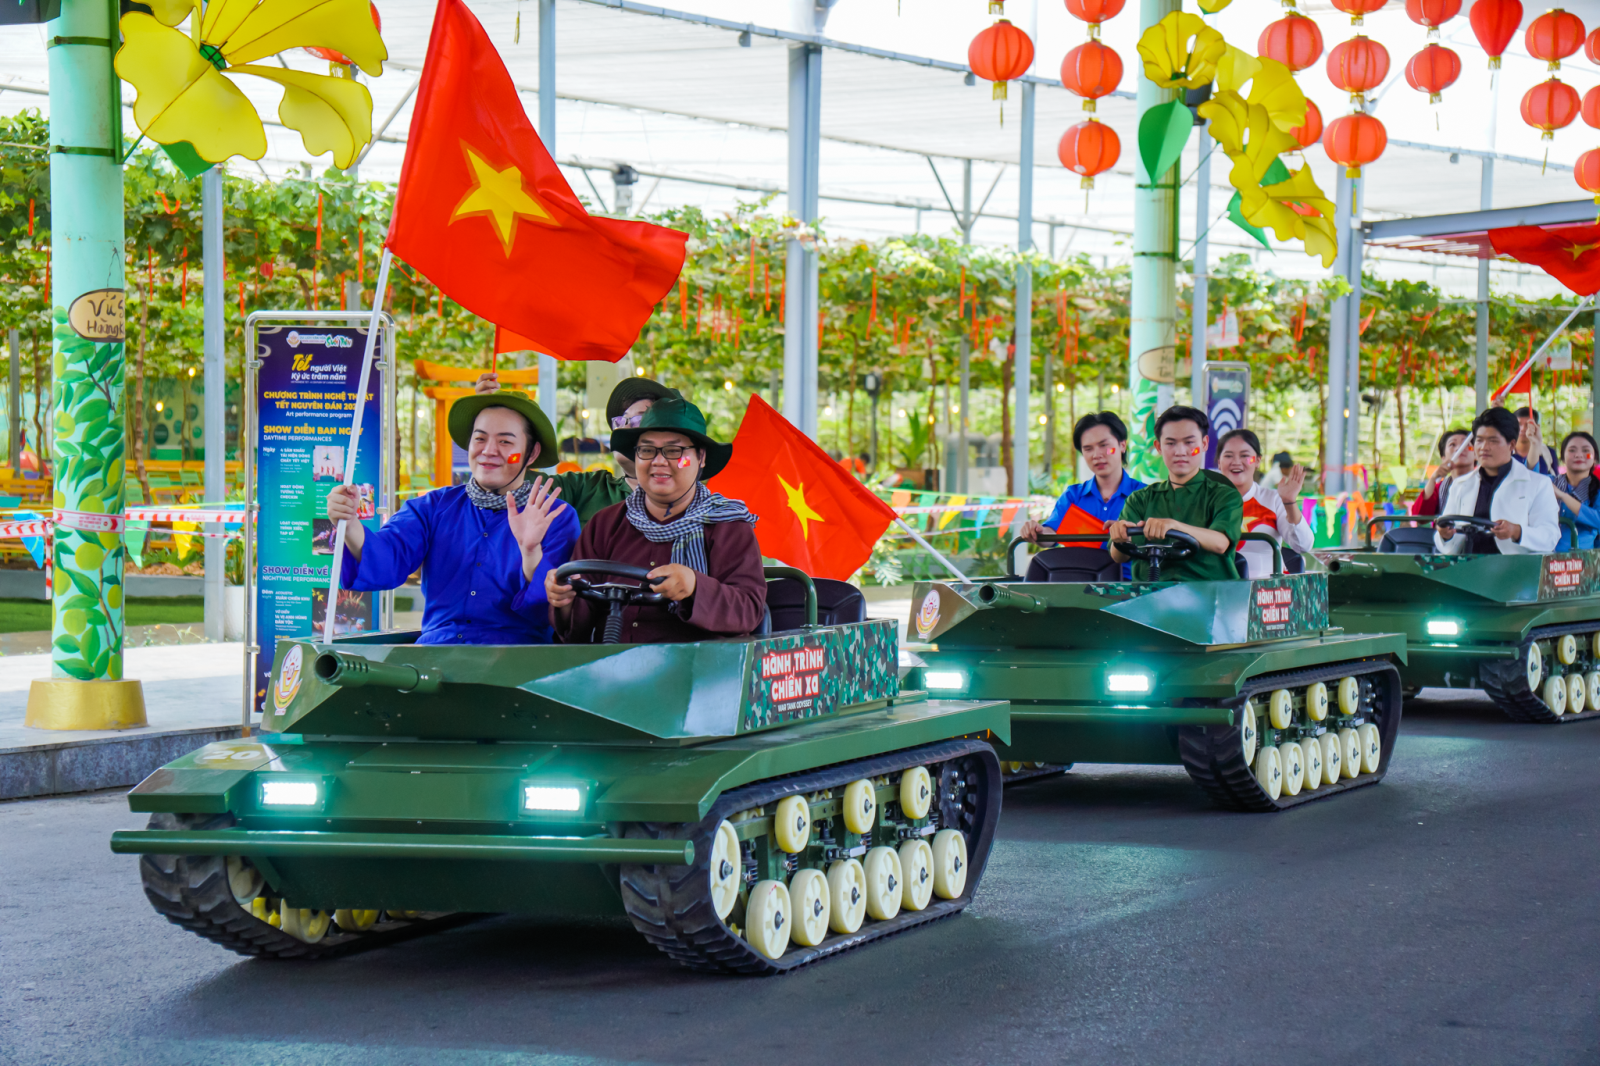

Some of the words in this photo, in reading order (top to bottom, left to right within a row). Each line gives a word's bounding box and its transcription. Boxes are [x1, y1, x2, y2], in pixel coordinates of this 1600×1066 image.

[87, 294, 117, 317] Vú
[292, 354, 313, 371] Tết
[310, 364, 331, 373] người
[332, 364, 347, 373] Việt
[301, 372, 310, 380] ức
[311, 372, 329, 380] trăm
[264, 391, 298, 399] CHƯƠNG
[299, 391, 323, 400] TRÌNH
[324, 391, 346, 402] NGHỆ
[348, 392, 374, 402] THẬT
[275, 400, 290, 409] TẾT
[291, 401, 323, 410] NGUYÊN
[324, 401, 342, 410] ĐÁN
[264, 425, 292, 434] SHOW
[294, 423, 315, 435] DIỄN
[317, 427, 337, 435] BAN
[339, 427, 364, 435] NGY
[262, 565, 291, 574] SHOW
[293, 564, 315, 575] DIỄN
[316, 564, 329, 576] VỀ
[1274, 587, 1292, 604] TRÌNH
[793, 647, 824, 673] TRÌNH
[787, 702, 796, 711] TANK
[796, 698, 813, 709] ODYSSEY
